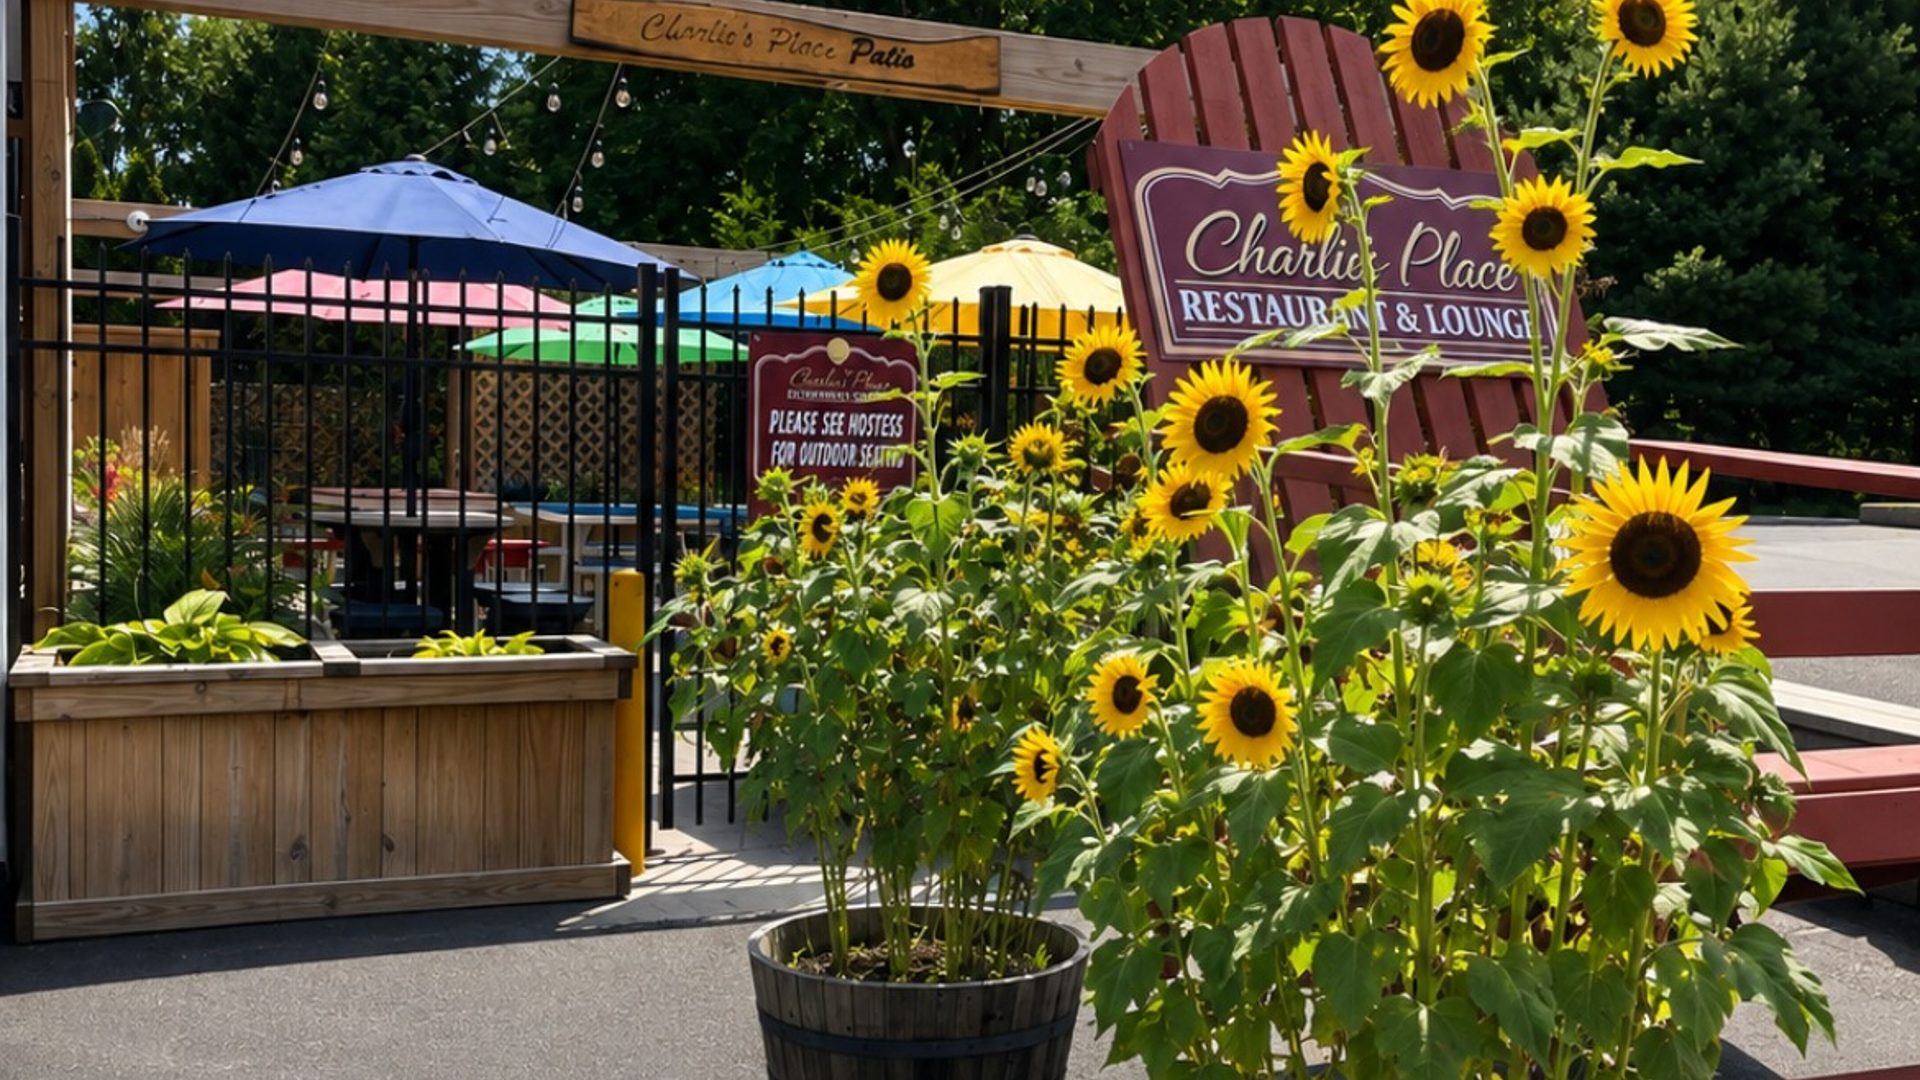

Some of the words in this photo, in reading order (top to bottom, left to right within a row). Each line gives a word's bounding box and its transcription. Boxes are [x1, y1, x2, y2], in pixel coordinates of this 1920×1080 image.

[767, 27, 836, 60] Place
[849, 37, 915, 69] Patio
[1400, 221, 1518, 292] Place
[1395, 302, 1422, 333] &
[769, 409, 819, 435] PLEASE
[821, 411, 845, 436] SEE
[848, 412, 904, 438] HOSTESS
[799, 441, 857, 467] OUTDOOR
